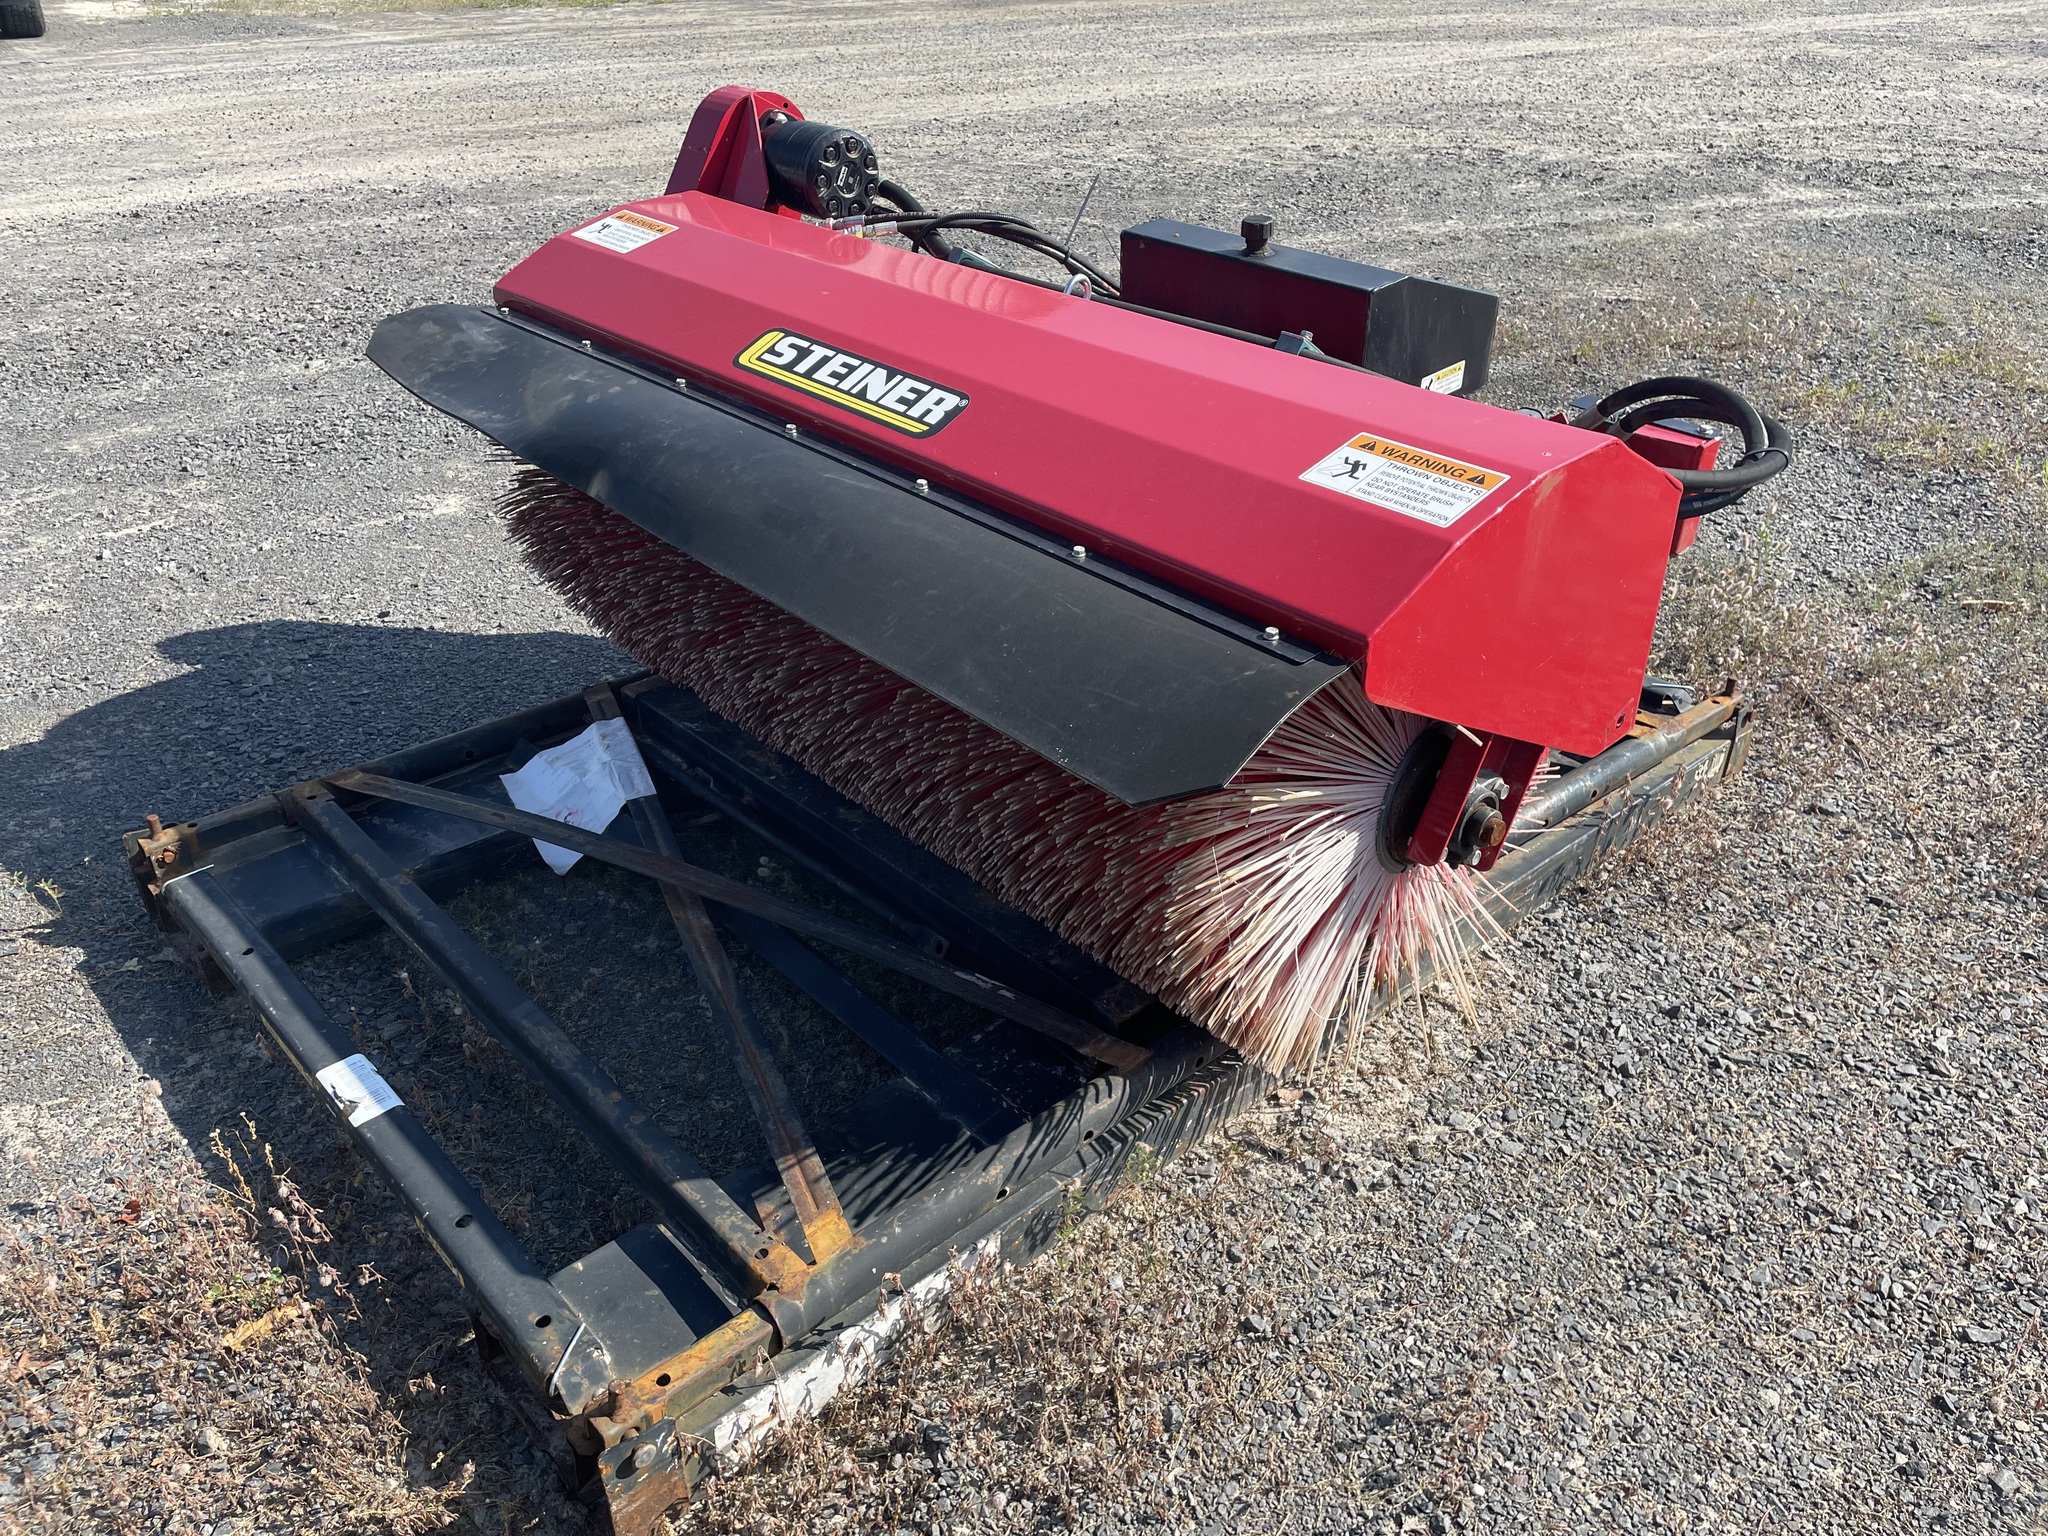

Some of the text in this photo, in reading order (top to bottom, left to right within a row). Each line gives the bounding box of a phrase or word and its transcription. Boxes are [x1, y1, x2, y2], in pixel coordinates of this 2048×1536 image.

[760, 336, 961, 425] STEINER
[1381, 446, 1467, 478] WARNING
[1365, 481, 1430, 506] NEAR BYSTANDERS
[1380, 470, 1473, 503] REMOVE POTENTIAL THROWN OBJECTS
[1382, 480, 1398, 488] NOT
[1397, 484, 1431, 498] OPERATE
[1429, 495, 1455, 507] BRUSH
[1387, 462, 1483, 496] THROWN OBJECTS
[1356, 487, 1375, 496] STAND
[1374, 493, 1394, 502] CLEAR
[1393, 499, 1411, 509] WHEN
[1416, 506, 1449, 522] OPERATION
